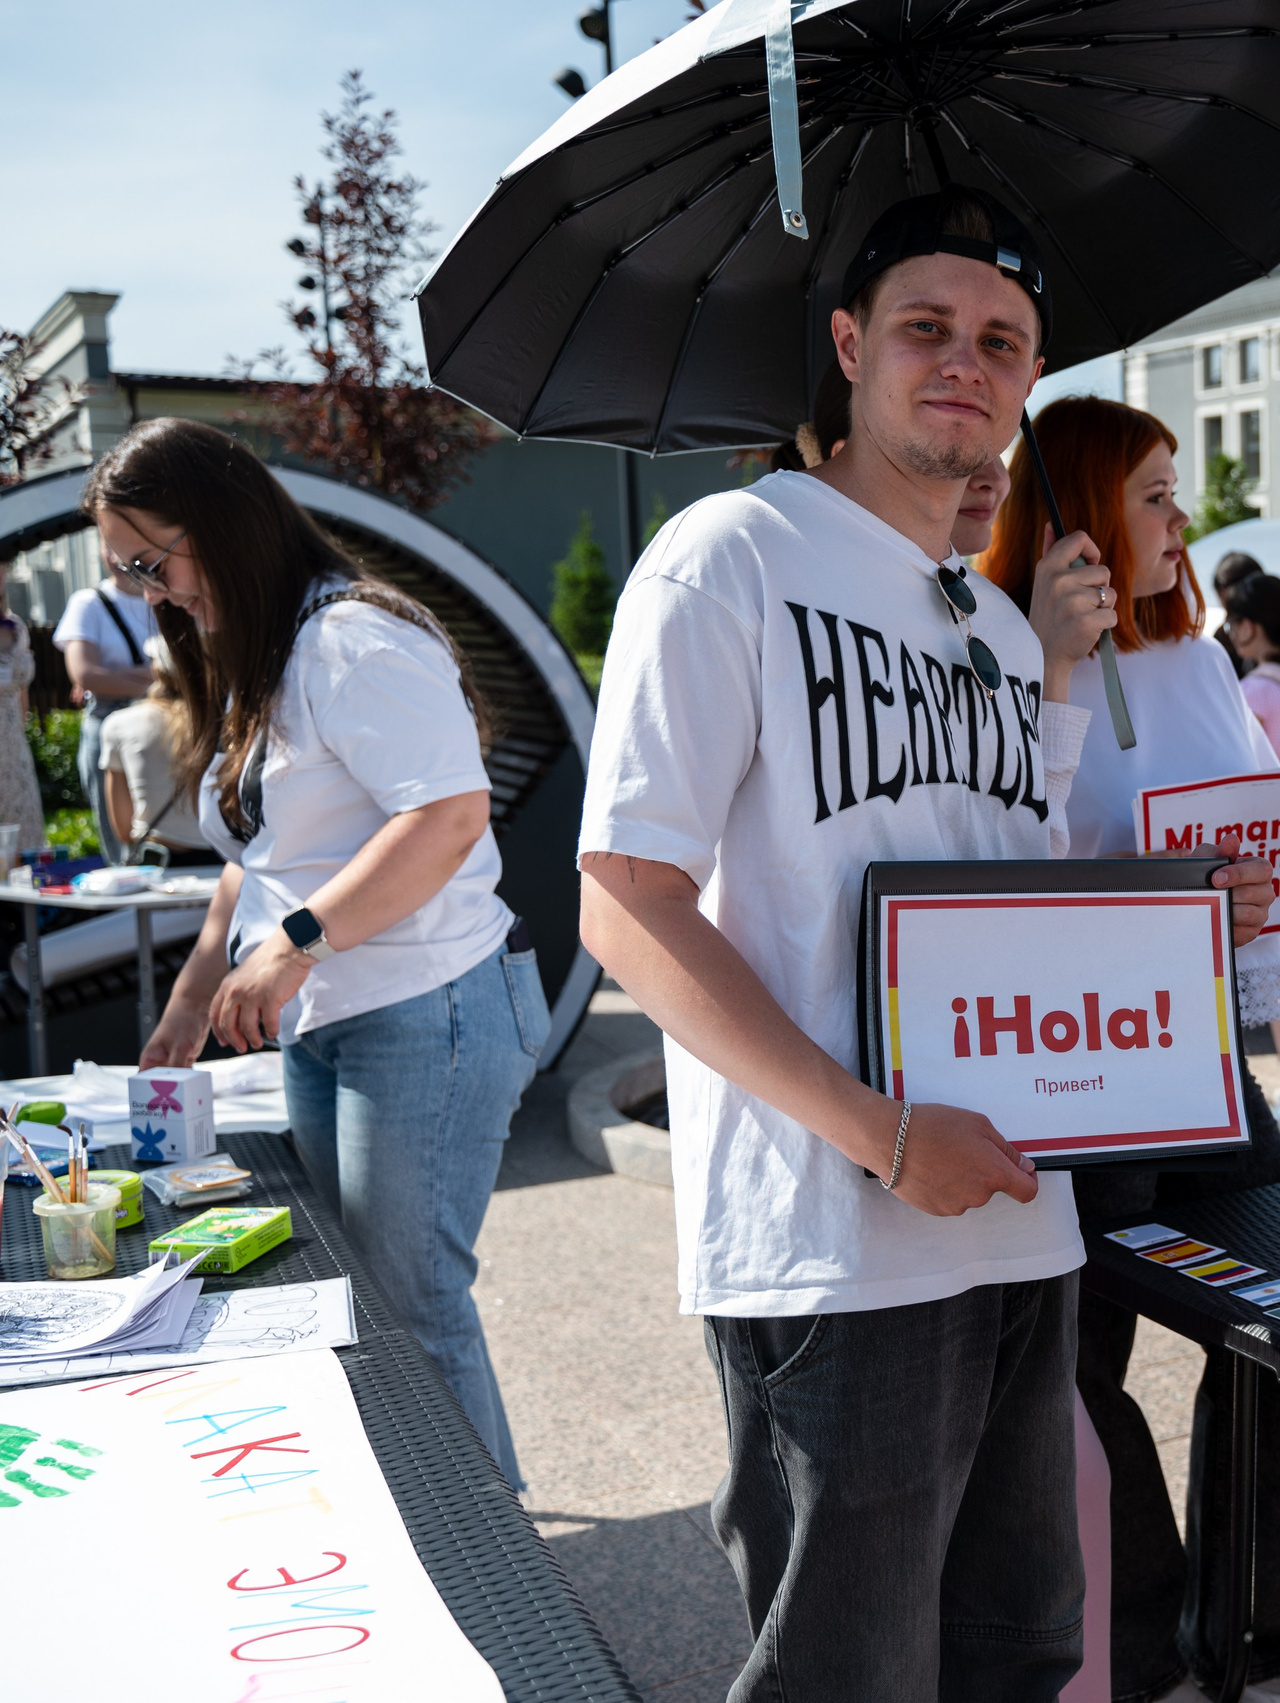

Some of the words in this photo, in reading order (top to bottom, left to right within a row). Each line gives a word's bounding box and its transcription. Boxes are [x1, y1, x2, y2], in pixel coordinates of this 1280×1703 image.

[951, 990, 1173, 1058] ¡Hola!
[1035, 1075, 1104, 1097] Привет!
[78, 1370, 334, 1522] ПЛАКАТ
